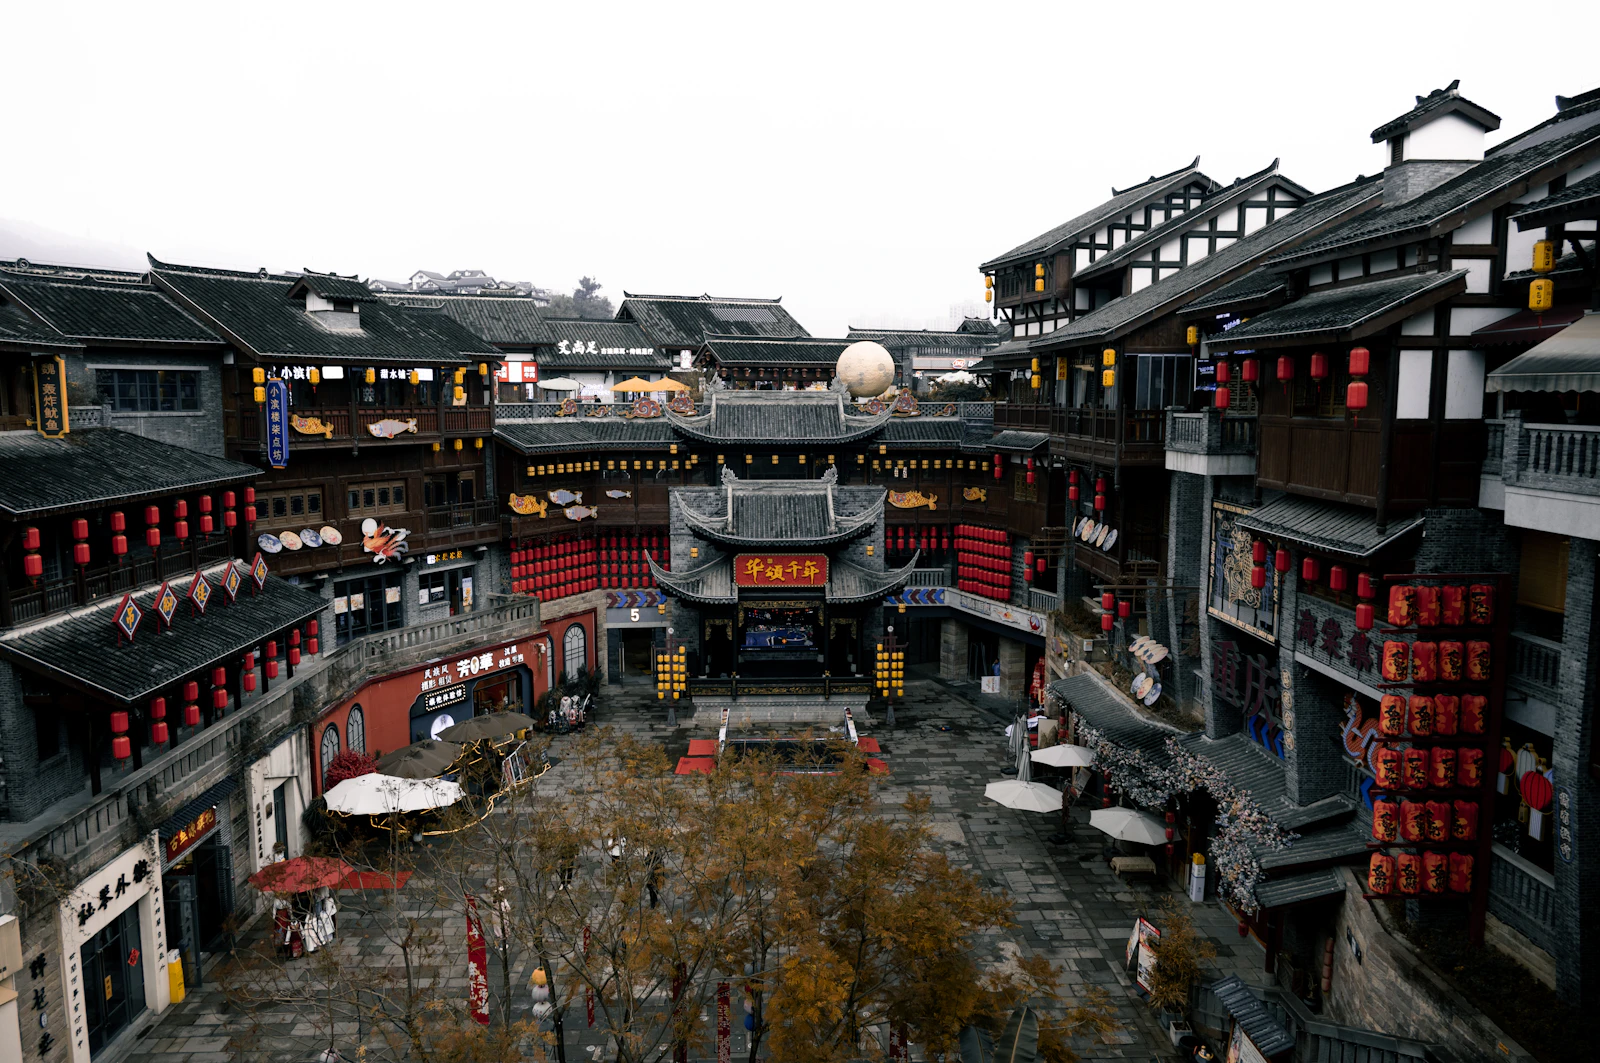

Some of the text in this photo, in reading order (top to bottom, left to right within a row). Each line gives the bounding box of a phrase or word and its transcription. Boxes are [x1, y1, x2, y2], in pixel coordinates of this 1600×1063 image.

[630, 608, 640, 622] 5
[1297, 608, 1384, 674] 海棠集
